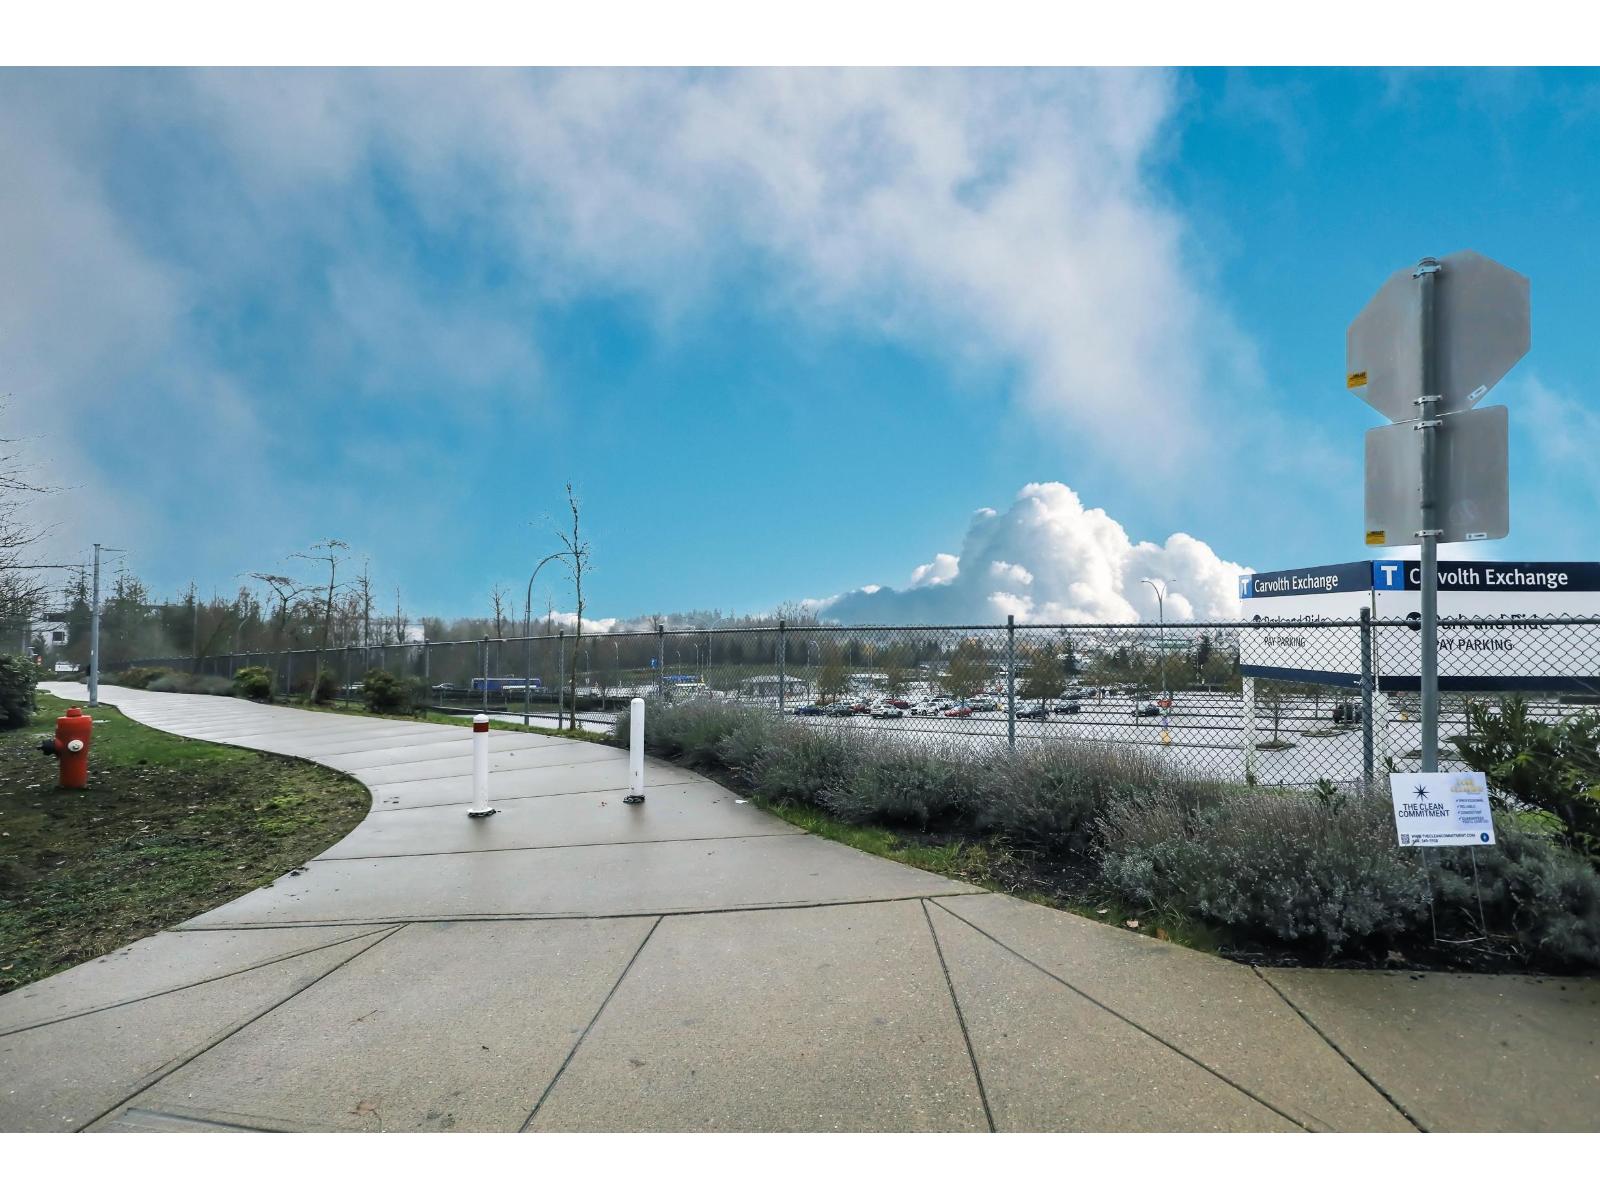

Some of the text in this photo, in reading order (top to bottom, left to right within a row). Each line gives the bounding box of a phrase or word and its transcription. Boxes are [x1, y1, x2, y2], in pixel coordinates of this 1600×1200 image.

[1381, 565, 1398, 586] T
[1409, 567, 1568, 589] Cvolth Exchange
[1254, 573, 1338, 593] Carvolth Exchange
[1264, 636, 1306, 647] PAY PARKING
[1437, 639, 1513, 651] AY PARKING
[1402, 803, 1444, 811] THE CLEAN
[1398, 809, 1450, 818] COMMITMENT
